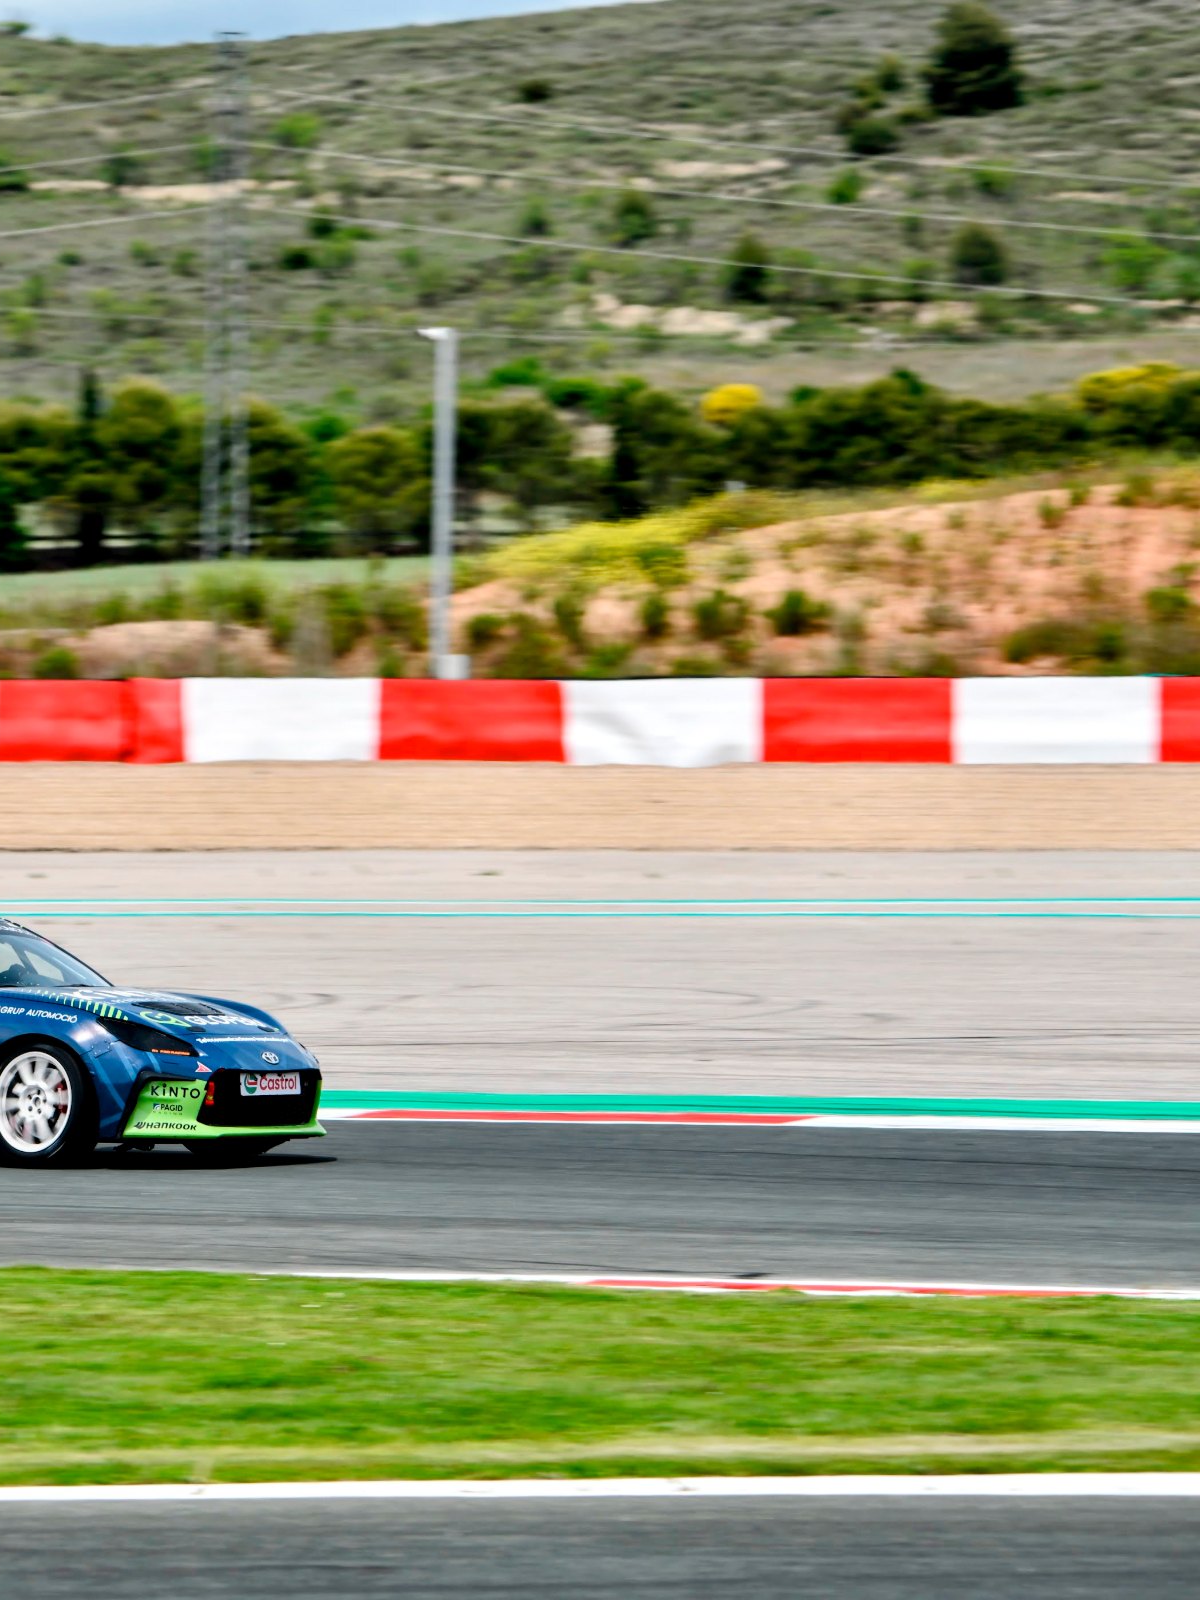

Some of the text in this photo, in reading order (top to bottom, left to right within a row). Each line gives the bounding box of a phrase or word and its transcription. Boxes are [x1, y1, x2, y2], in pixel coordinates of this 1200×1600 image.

[26, 1008, 78, 1024] AUTOMOCIÓ
[260, 1075, 297, 1090] Castrol
[160, 1103, 183, 1112] PAGID
